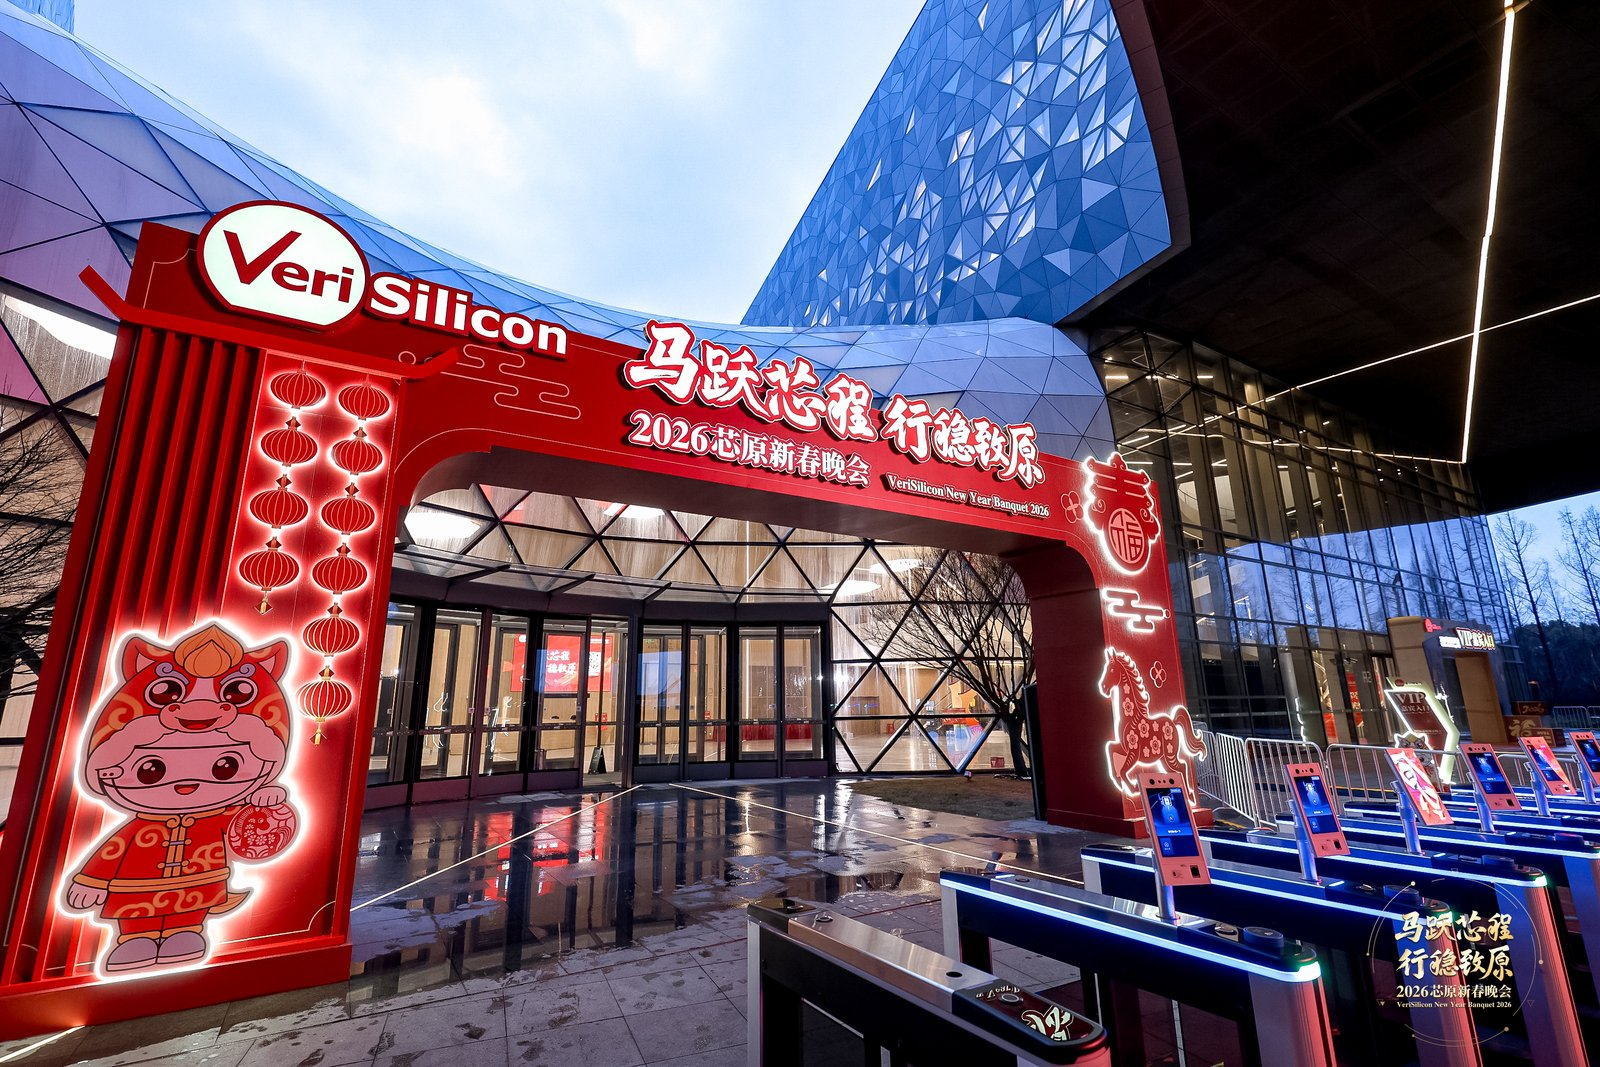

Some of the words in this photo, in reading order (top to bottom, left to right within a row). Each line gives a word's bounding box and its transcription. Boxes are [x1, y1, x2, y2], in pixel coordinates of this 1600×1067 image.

[626, 321, 877, 440] 马跃芯程
[883, 397, 1045, 486] 行稳致原
[630, 411, 871, 486] 2026芯原新春晚会
[887, 473, 944, 497] VeriSilicon
[945, 486, 967, 501] New
[969, 491, 992, 506] Year
[993, 496, 1029, 515] Banquet
[1030, 504, 1050, 518] 2026
[1395, 693, 1425, 704] VIP
